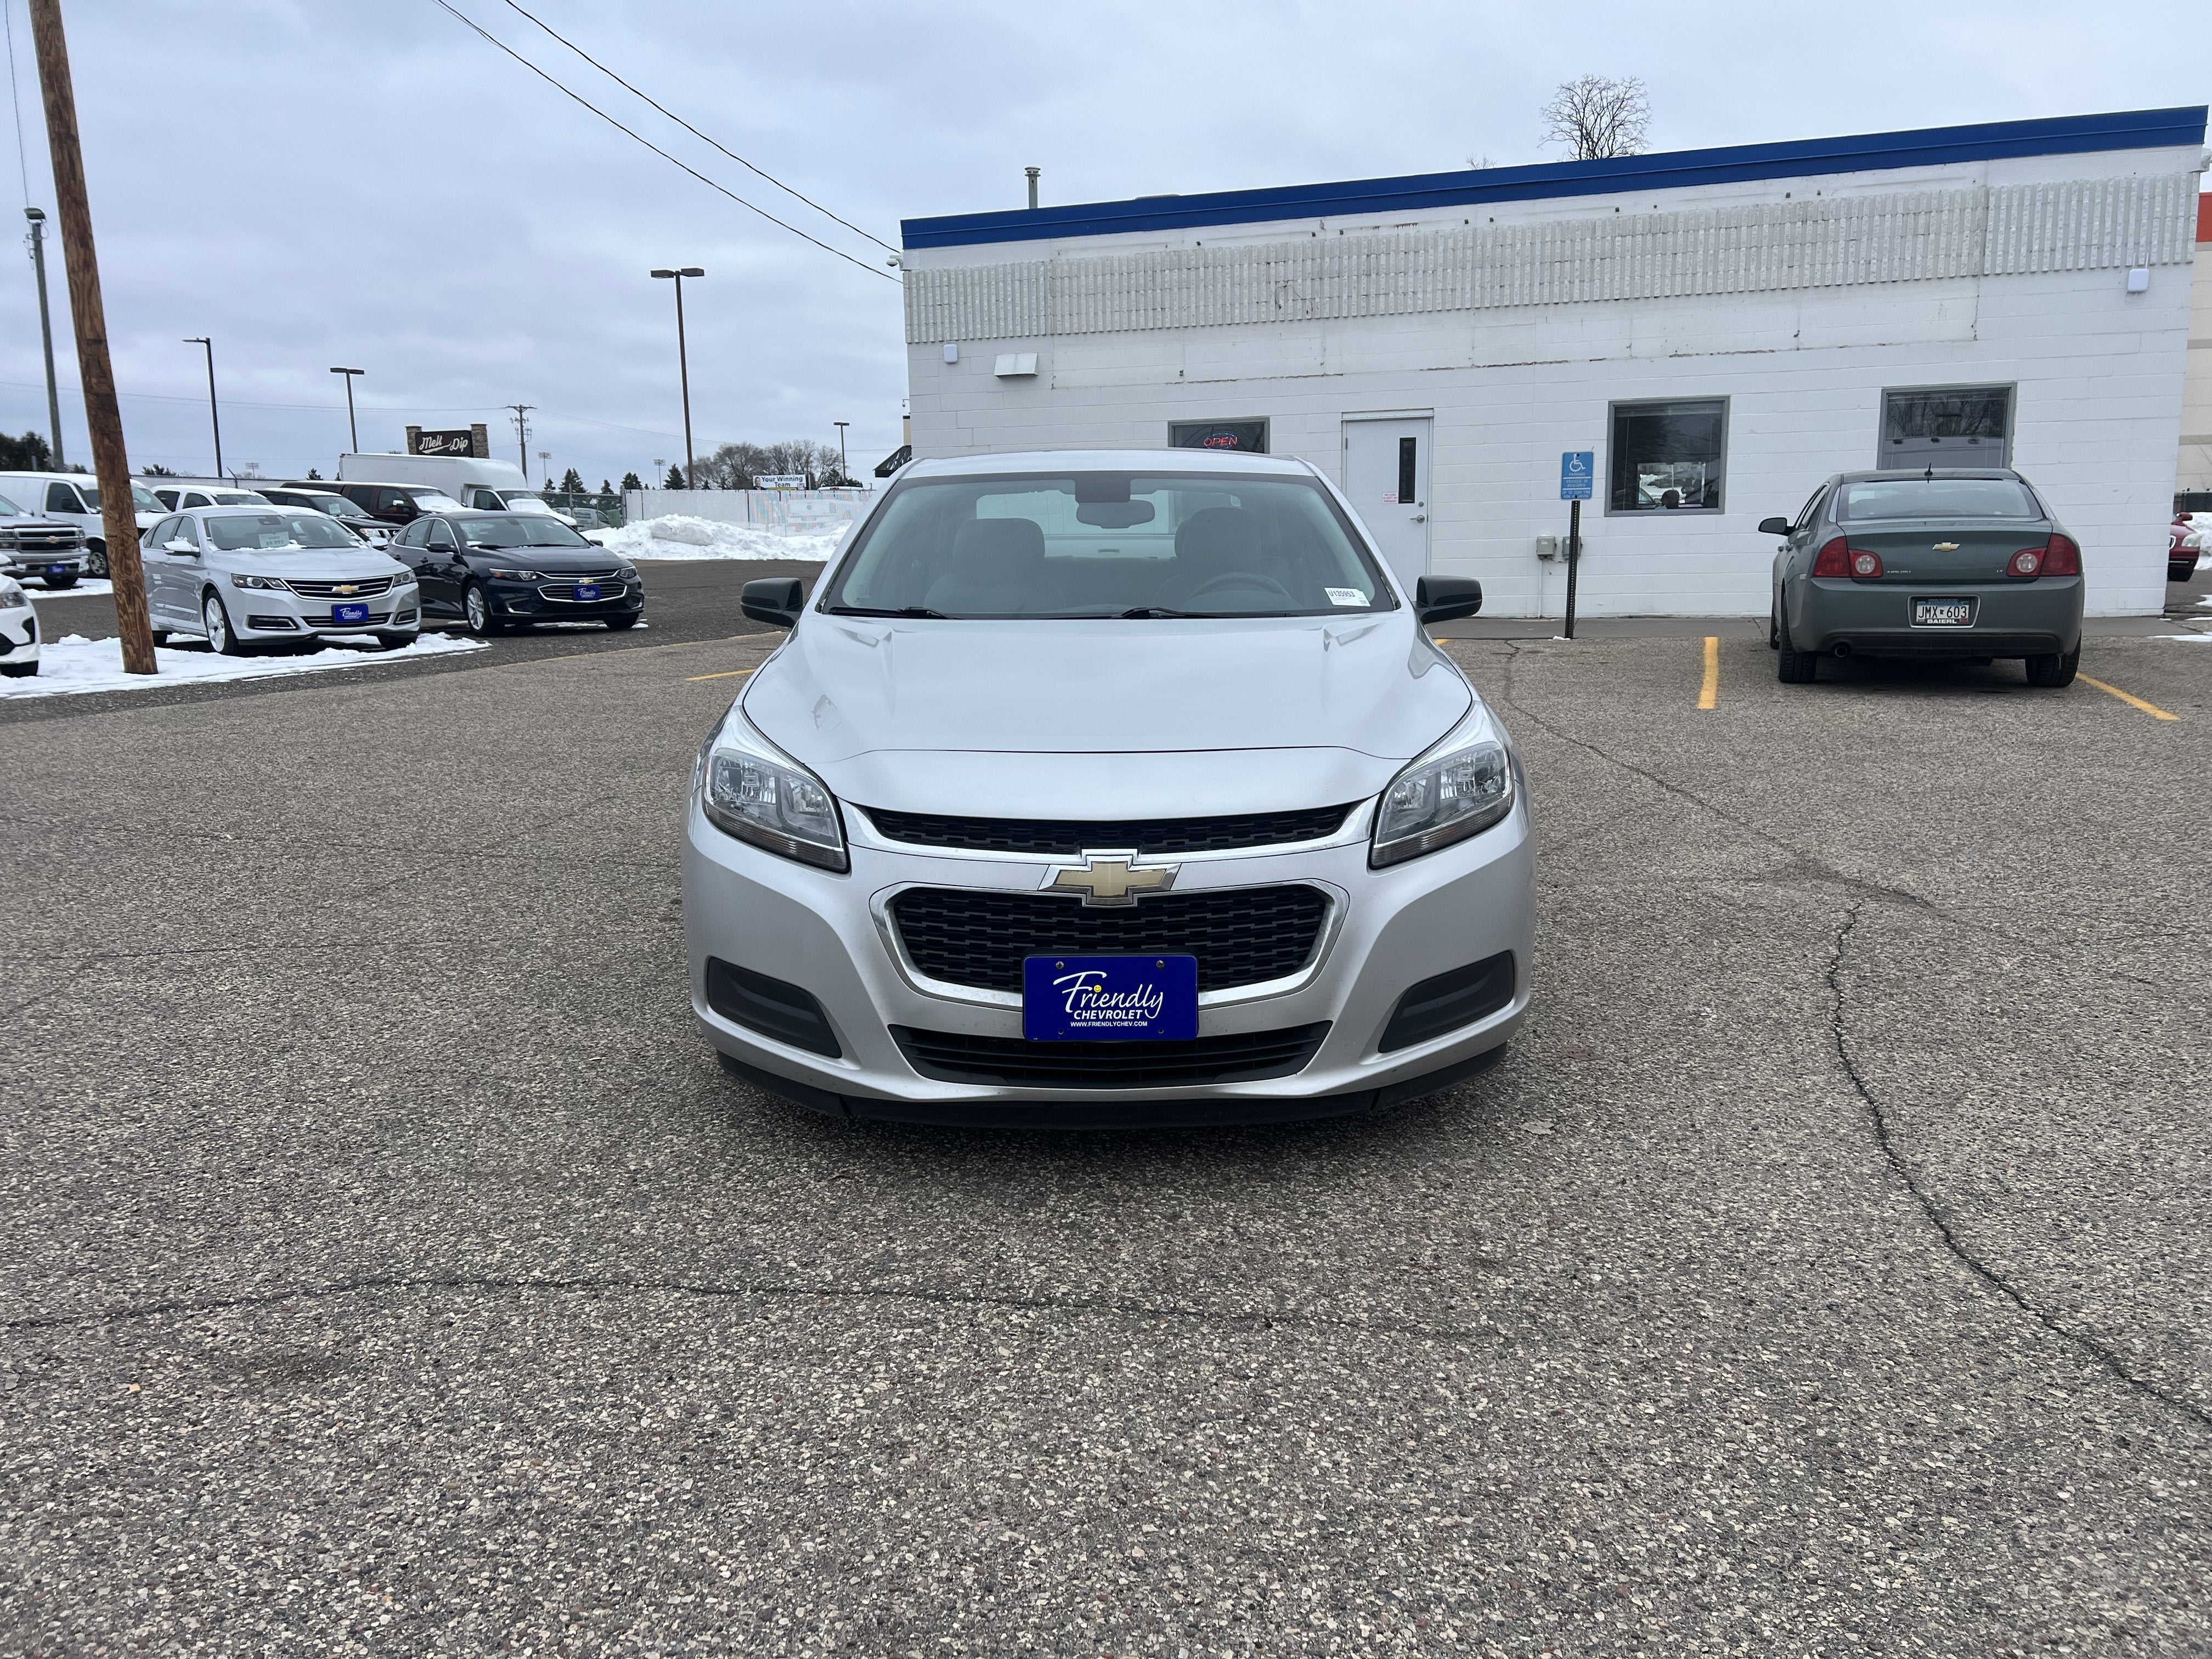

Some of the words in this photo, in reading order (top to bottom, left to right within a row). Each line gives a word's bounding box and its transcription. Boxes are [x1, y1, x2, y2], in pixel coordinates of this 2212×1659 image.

[419, 435, 443, 450] Melt
[449, 437, 468, 452] Dip
[1203, 436, 1238, 447] OPEN
[339, 607, 362, 618] Friendly
[1918, 606, 1938, 618] JMX
[1946, 606, 1967, 618] 603
[1053, 970, 1164, 1019] Friendly
[1074, 1010, 1143, 1020] CHEVROLET
